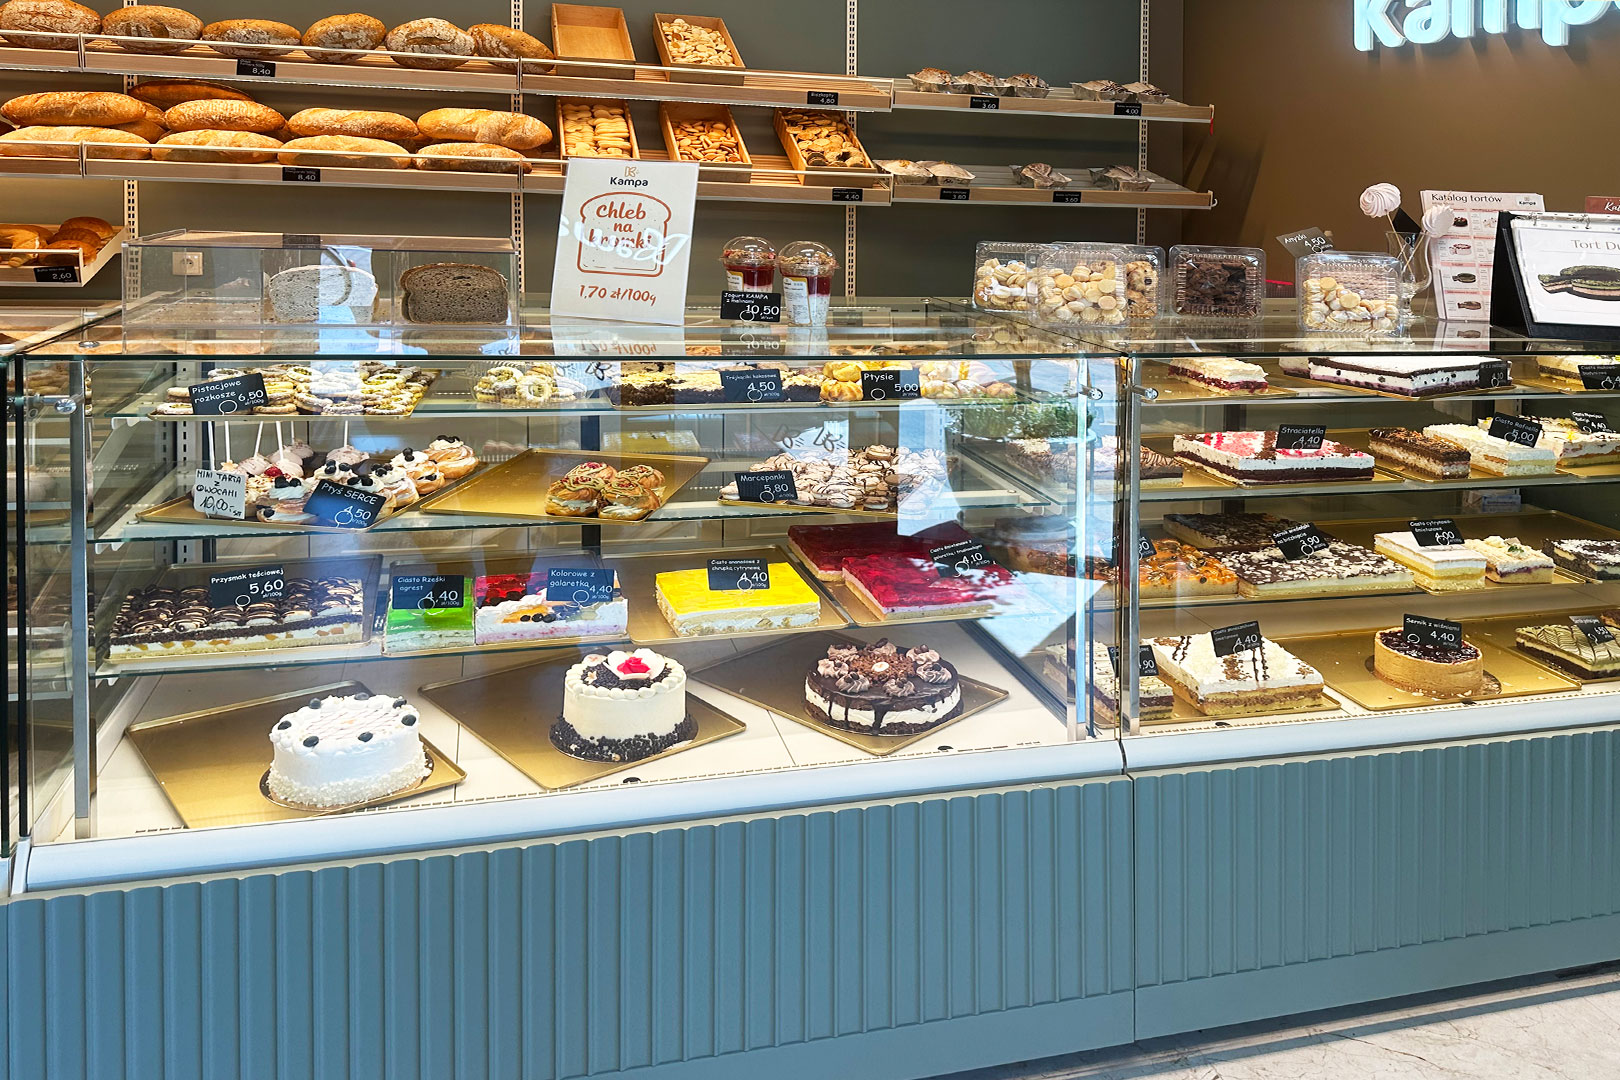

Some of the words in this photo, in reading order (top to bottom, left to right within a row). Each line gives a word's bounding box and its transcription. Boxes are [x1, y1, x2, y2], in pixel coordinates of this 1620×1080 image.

[1354, 0, 1620, 51] Kamp
[252, 67, 271, 75] 8,40
[610, 176, 649, 188] Kampa
[1431, 193, 1468, 204] Katalog
[1470, 194, 1503, 203] tortów
[613, 222, 634, 233] na
[1304, 236, 1326, 247] 450
[1571, 239, 1601, 250] Tort
[52, 272, 72, 280] 2,60
[579, 284, 607, 299] 1,70
[610, 287, 657, 306] zł/100g
[724, 292, 744, 300] Jogurt
[746, 304, 779, 316] 10,50
[864, 373, 895, 383] Ptysie
[192, 379, 242, 394] Pistacjowe
[894, 383, 919, 393] 5,00
[194, 390, 237, 404] rozkosze
[238, 389, 264, 402] 6,50
[1494, 416, 1514, 426] Ciasto
[1298, 436, 1320, 445] 4,40
[196, 470, 213, 479] MINI
[216, 473, 242, 484] TARTA
[740, 473, 786, 482] Marcepanki
[321, 482, 344, 495] Ptyś
[345, 490, 378, 505] SERCE
[764, 483, 789, 494] 5,80
[962, 552, 983, 564] 4,10
[211, 573, 247, 585] Przysmak
[249, 567, 284, 579] teściowej
[551, 569, 588, 577] Kolorowe
[422, 575, 446, 583] Rześki
[549, 579, 590, 588] galaretką
[249, 579, 284, 595] 5,60
[399, 585, 424, 593] agrest
[589, 585, 613, 594] 4,40
[424, 590, 458, 603] 4,40
[1405, 617, 1427, 627] Sernik
[1433, 621, 1460, 631] wiśniami
[1430, 630, 1455, 642] 4,40
[1138, 659, 1155, 670] ,90
